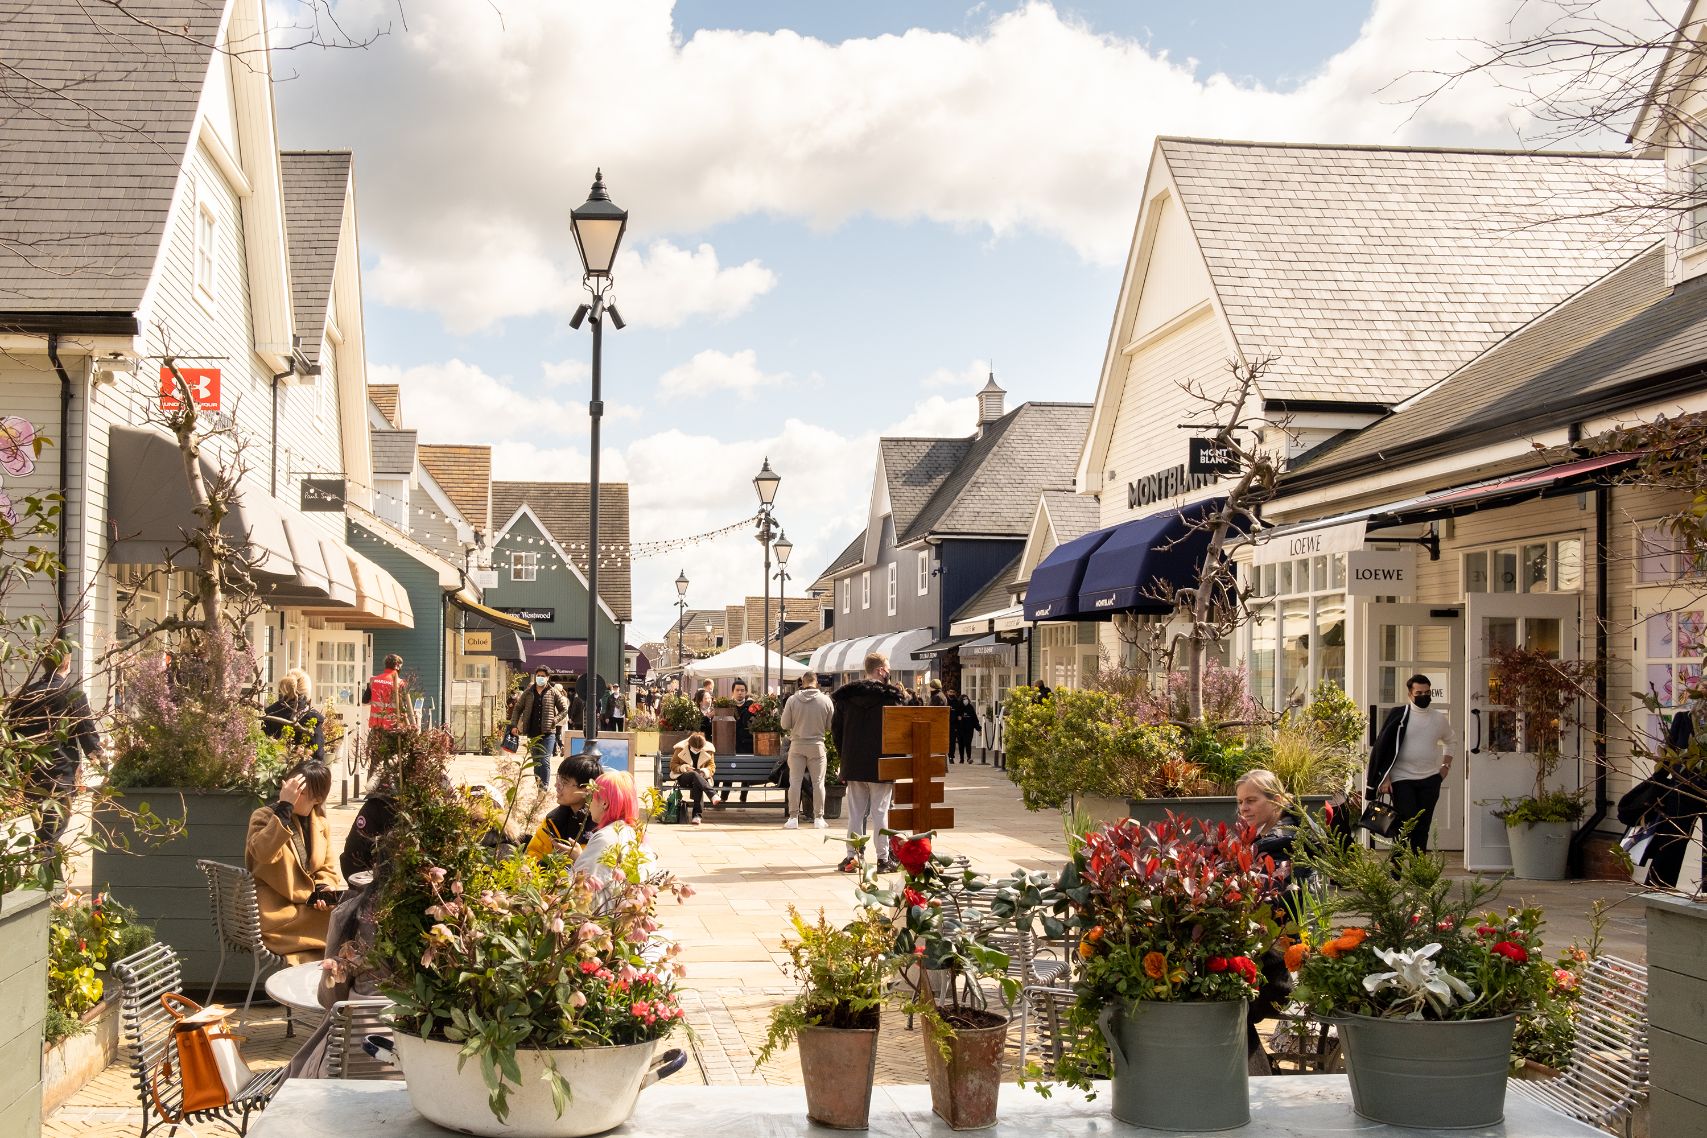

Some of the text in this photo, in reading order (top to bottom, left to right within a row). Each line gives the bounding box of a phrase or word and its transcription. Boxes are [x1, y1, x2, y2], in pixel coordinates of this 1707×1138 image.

[1200, 449, 1228, 457] MONT
[1200, 456, 1228, 464] BLANC
[1290, 534, 1322, 556] LOEWE
[1355, 569, 1403, 580] LOEWE
[520, 611, 551, 619] Westwood
[467, 638, 488, 646] Chloé
[1430, 688, 1444, 698] EWE
